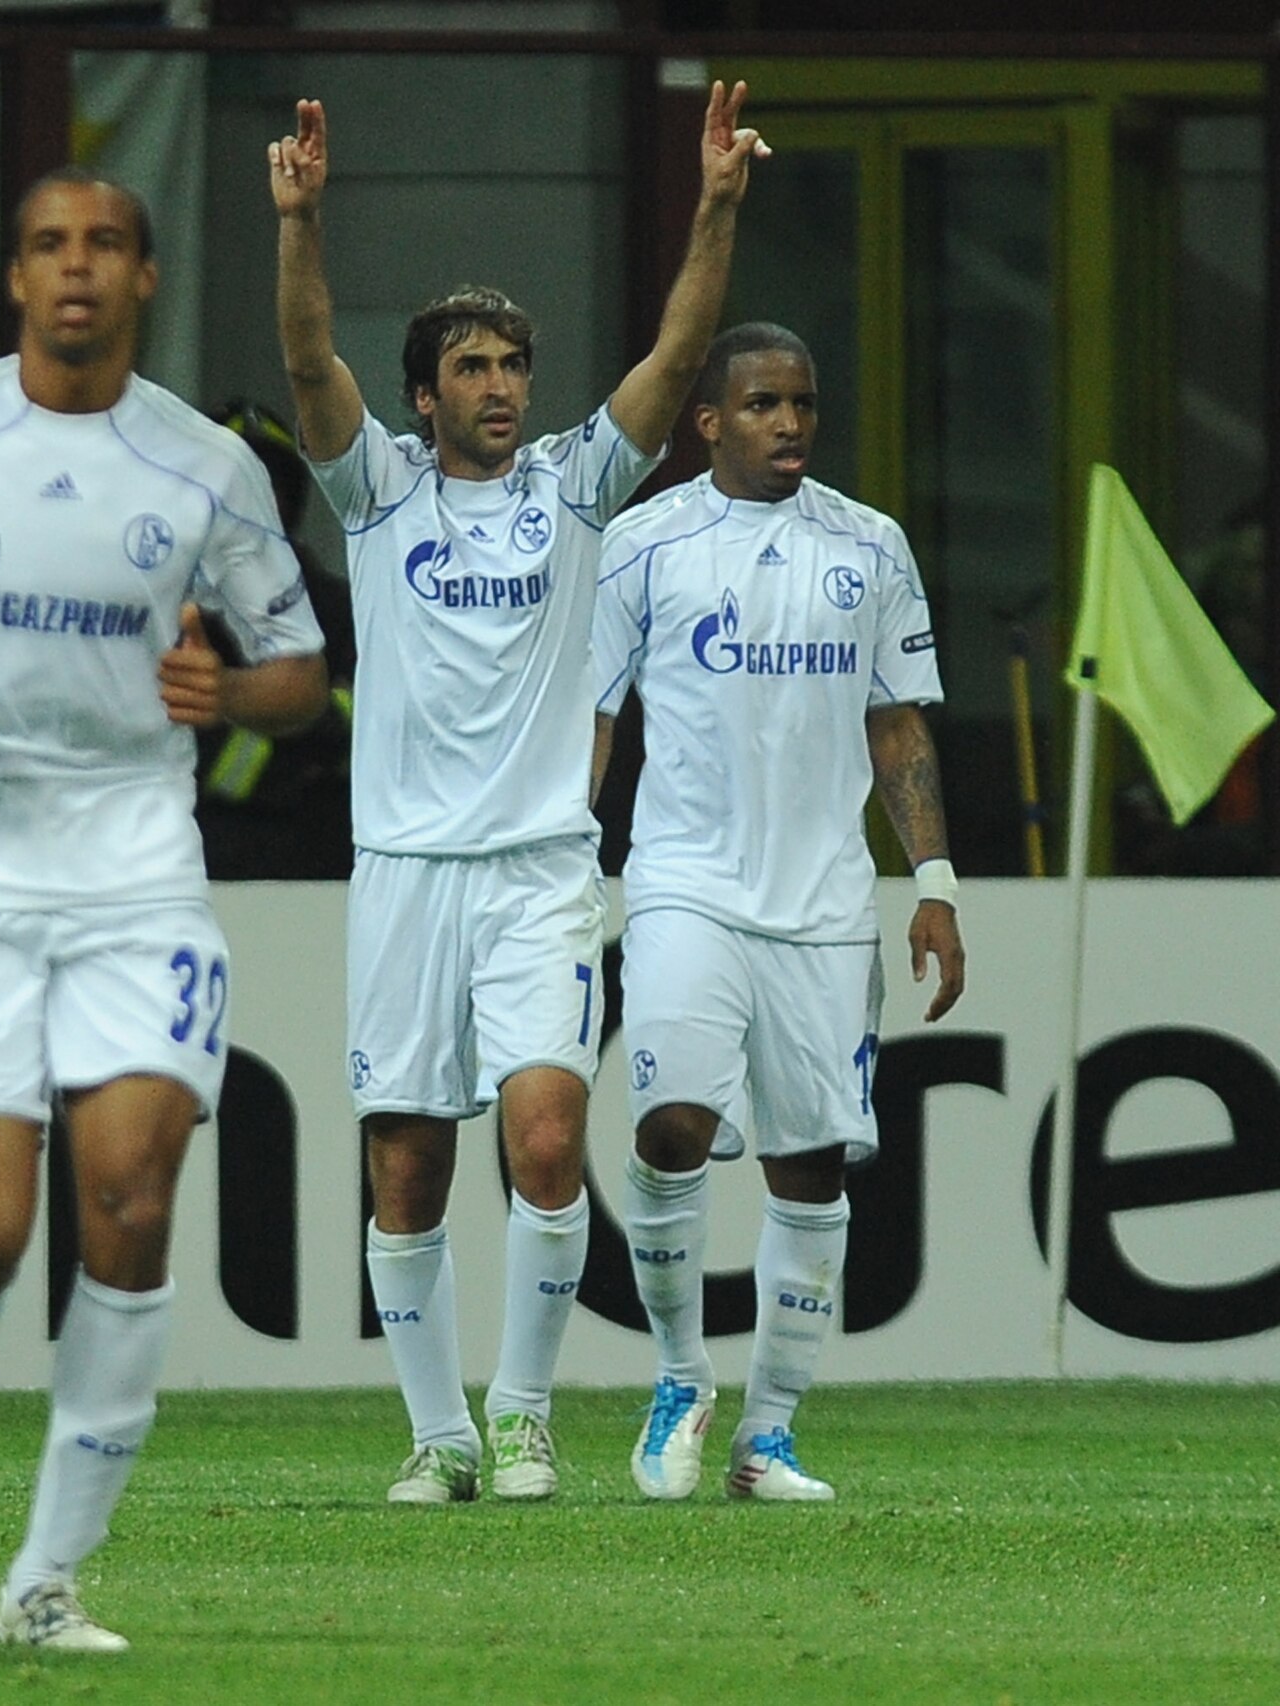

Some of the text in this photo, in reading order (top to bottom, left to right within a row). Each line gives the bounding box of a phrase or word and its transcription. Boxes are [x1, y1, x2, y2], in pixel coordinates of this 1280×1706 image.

[1, 591, 150, 636] GAZPROM
[746, 642, 857, 675] GAZPROM
[170, 944, 227, 1057] 32
[576, 962, 592, 1047] 7
[380, 1310, 420, 1323] 04
